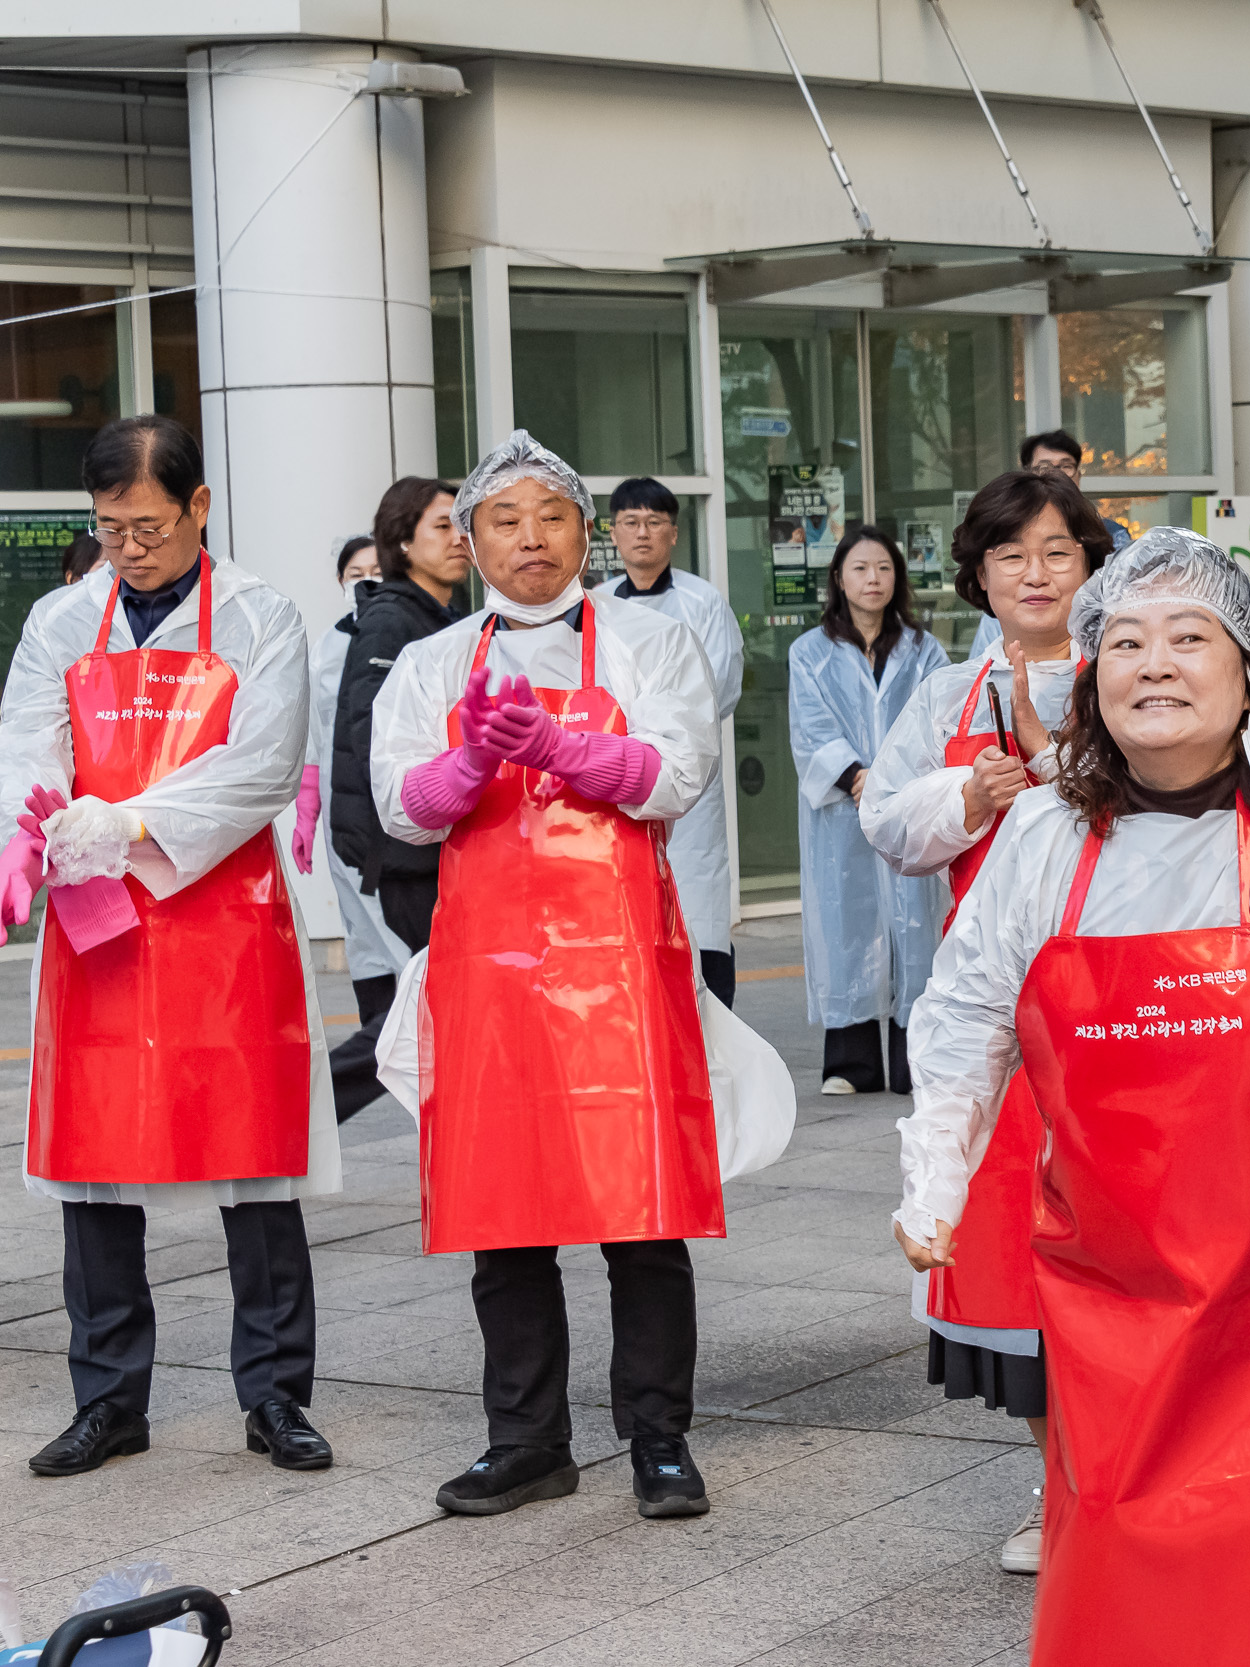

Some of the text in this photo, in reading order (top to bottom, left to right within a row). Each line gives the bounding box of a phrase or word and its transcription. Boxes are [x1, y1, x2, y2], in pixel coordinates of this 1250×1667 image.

[133, 697, 153, 705] 2024
[95, 711, 119, 722] 제2회
[134, 708, 163, 721] 사랑의
[549, 712, 589, 723] B국민은행
[1136, 1005, 1166, 1018] 2024
[1075, 1024, 1106, 1040] 제2회
[1110, 1023, 1139, 1040] 광진
[1142, 1020, 1185, 1038] 사랑의
